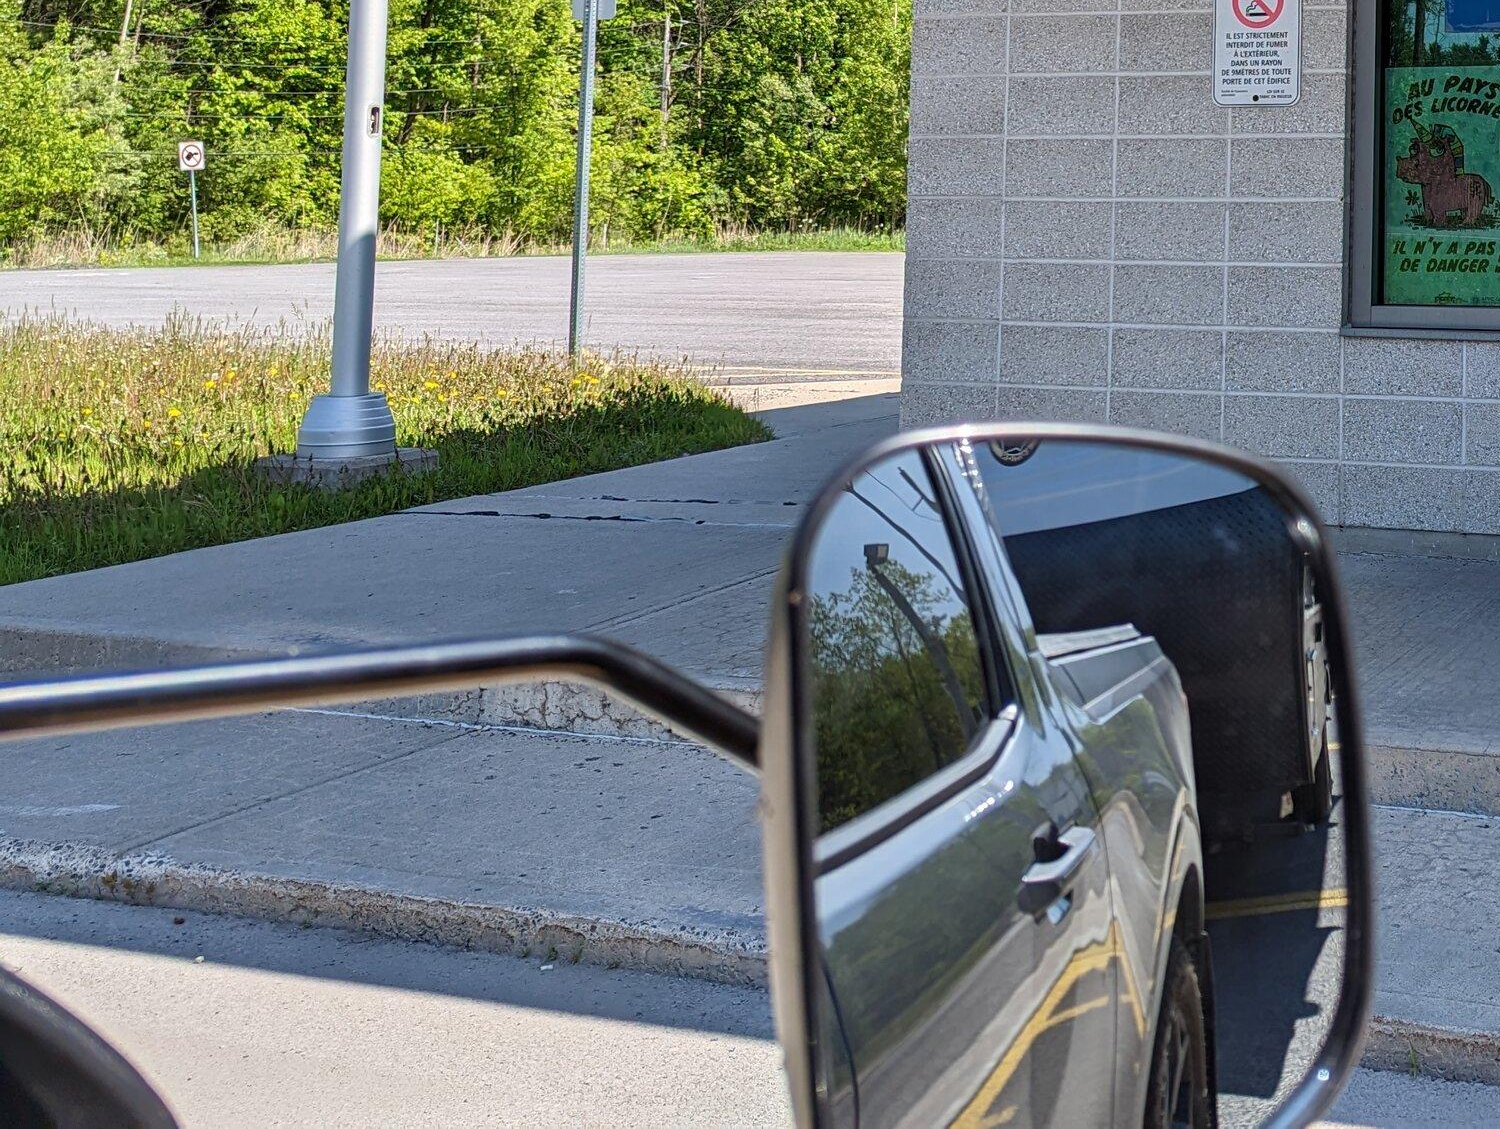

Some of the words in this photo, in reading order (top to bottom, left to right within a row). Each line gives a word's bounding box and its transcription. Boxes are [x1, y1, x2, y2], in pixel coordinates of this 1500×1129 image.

[1267, 76, 1290, 84] ÉDIFICE
[1408, 78, 1435, 99] AU
[1392, 101, 1423, 125] DES
[1446, 241, 1459, 256] A
[1464, 241, 1496, 256] PAS
[1400, 258, 1421, 273] DE
[1426, 258, 1490, 273] DANGER
